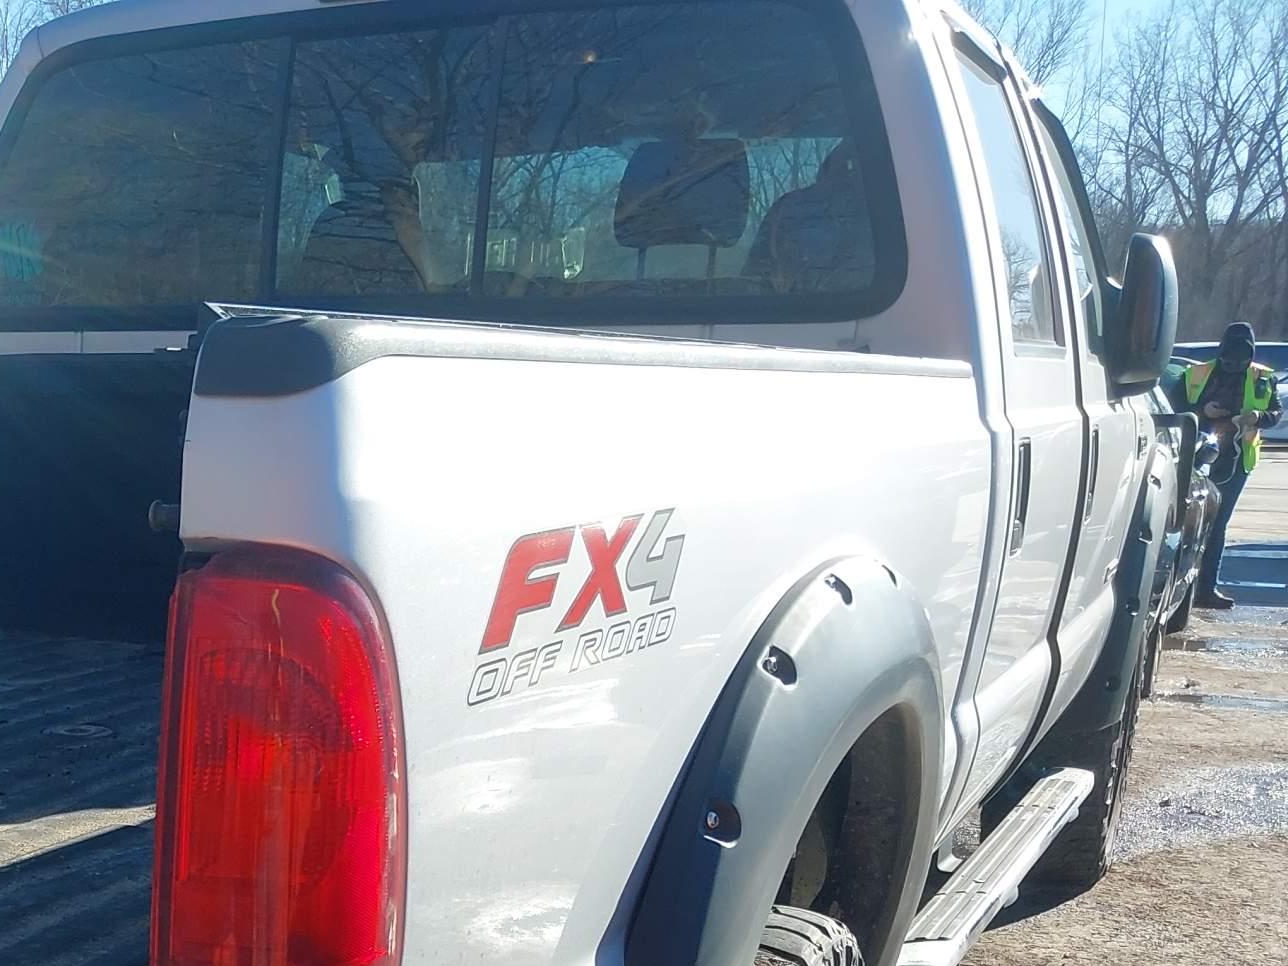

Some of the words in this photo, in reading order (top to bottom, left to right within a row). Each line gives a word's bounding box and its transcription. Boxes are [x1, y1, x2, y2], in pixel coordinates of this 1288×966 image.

[478, 507, 686, 656] FX4
[467, 639, 564, 707] OFF
[568, 606, 678, 673] ROAD
